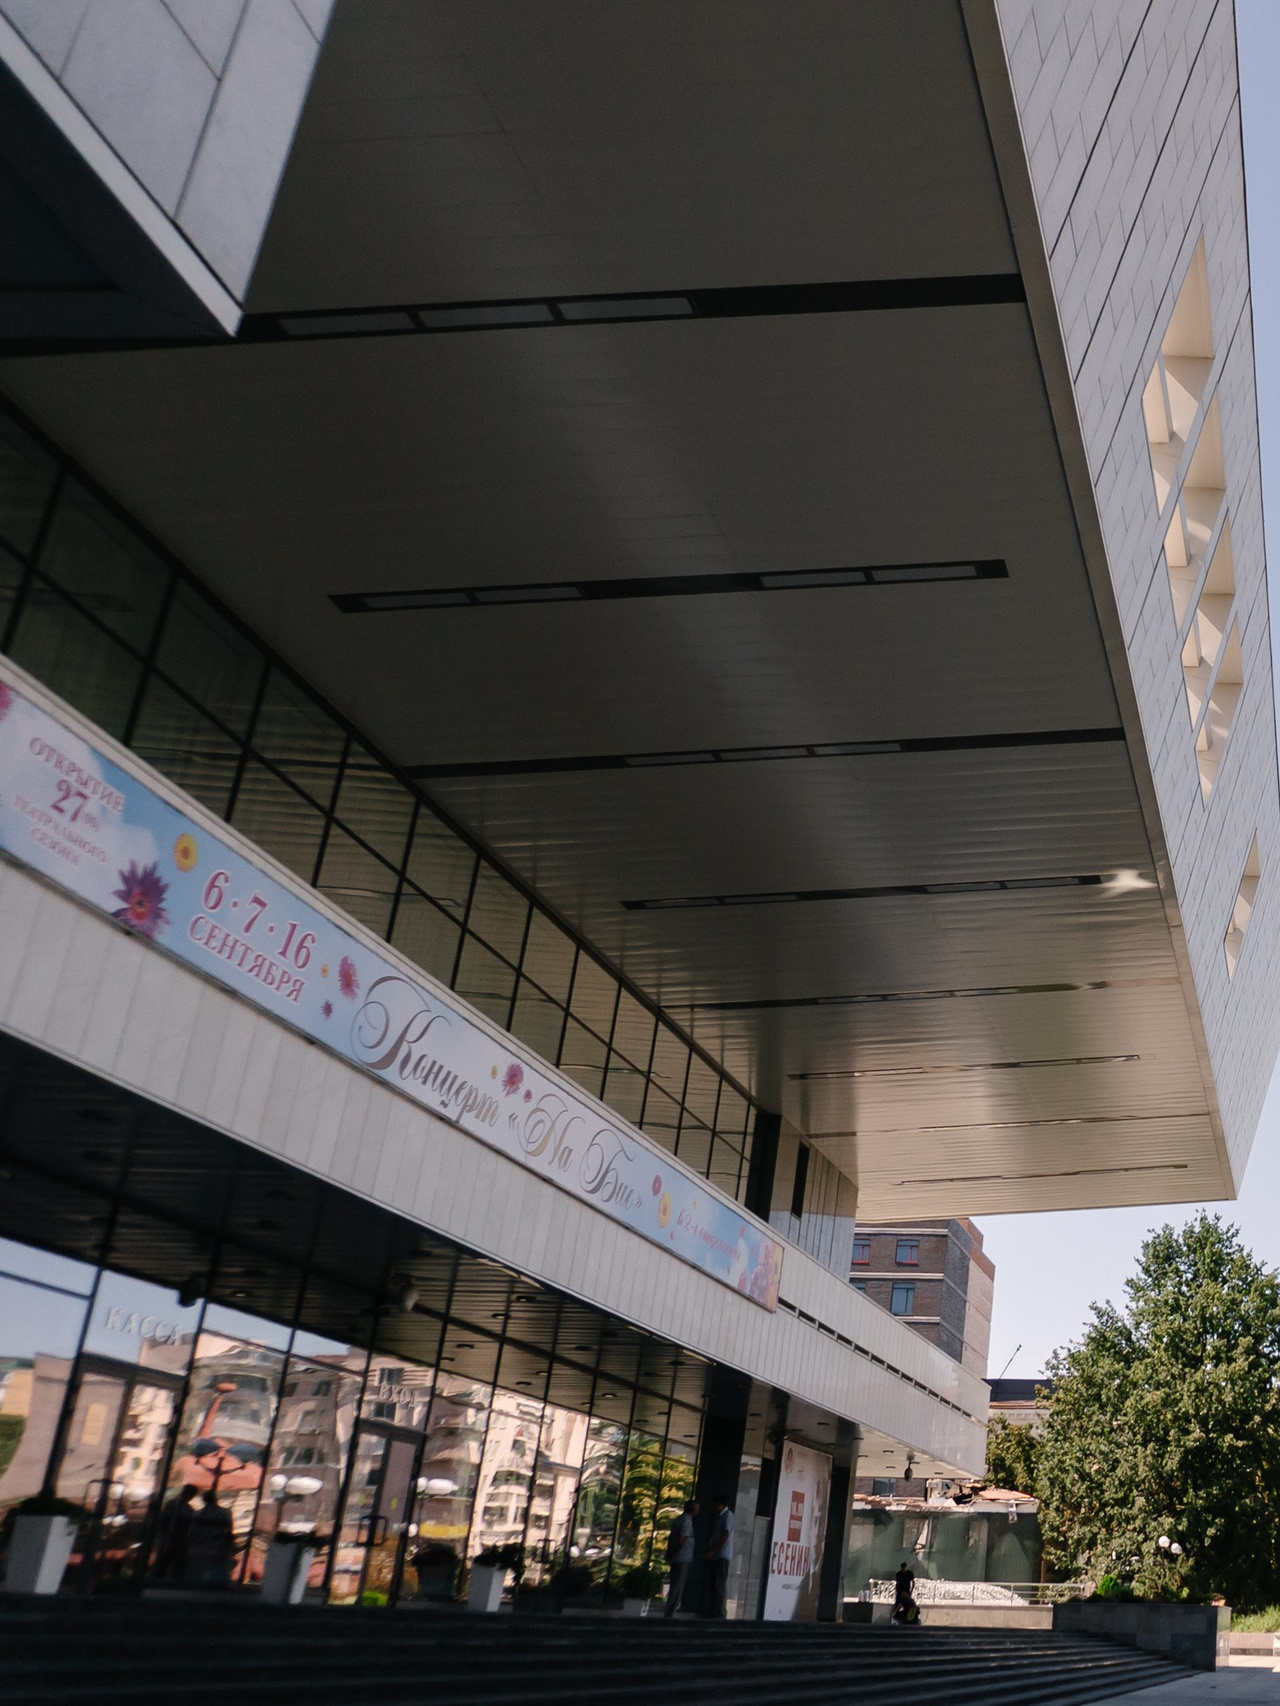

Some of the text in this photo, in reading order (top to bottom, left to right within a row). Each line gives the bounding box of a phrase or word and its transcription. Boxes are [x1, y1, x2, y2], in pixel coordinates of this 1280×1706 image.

[29, 737, 125, 813] ОТКРЫТИЕ
[188, 915, 305, 1003] СЕНТЯБРЯ
[350, 975, 500, 1125] Концерт
[104, 1306, 182, 1347] КАССА
[378, 1381, 418, 1410] ВХОД
